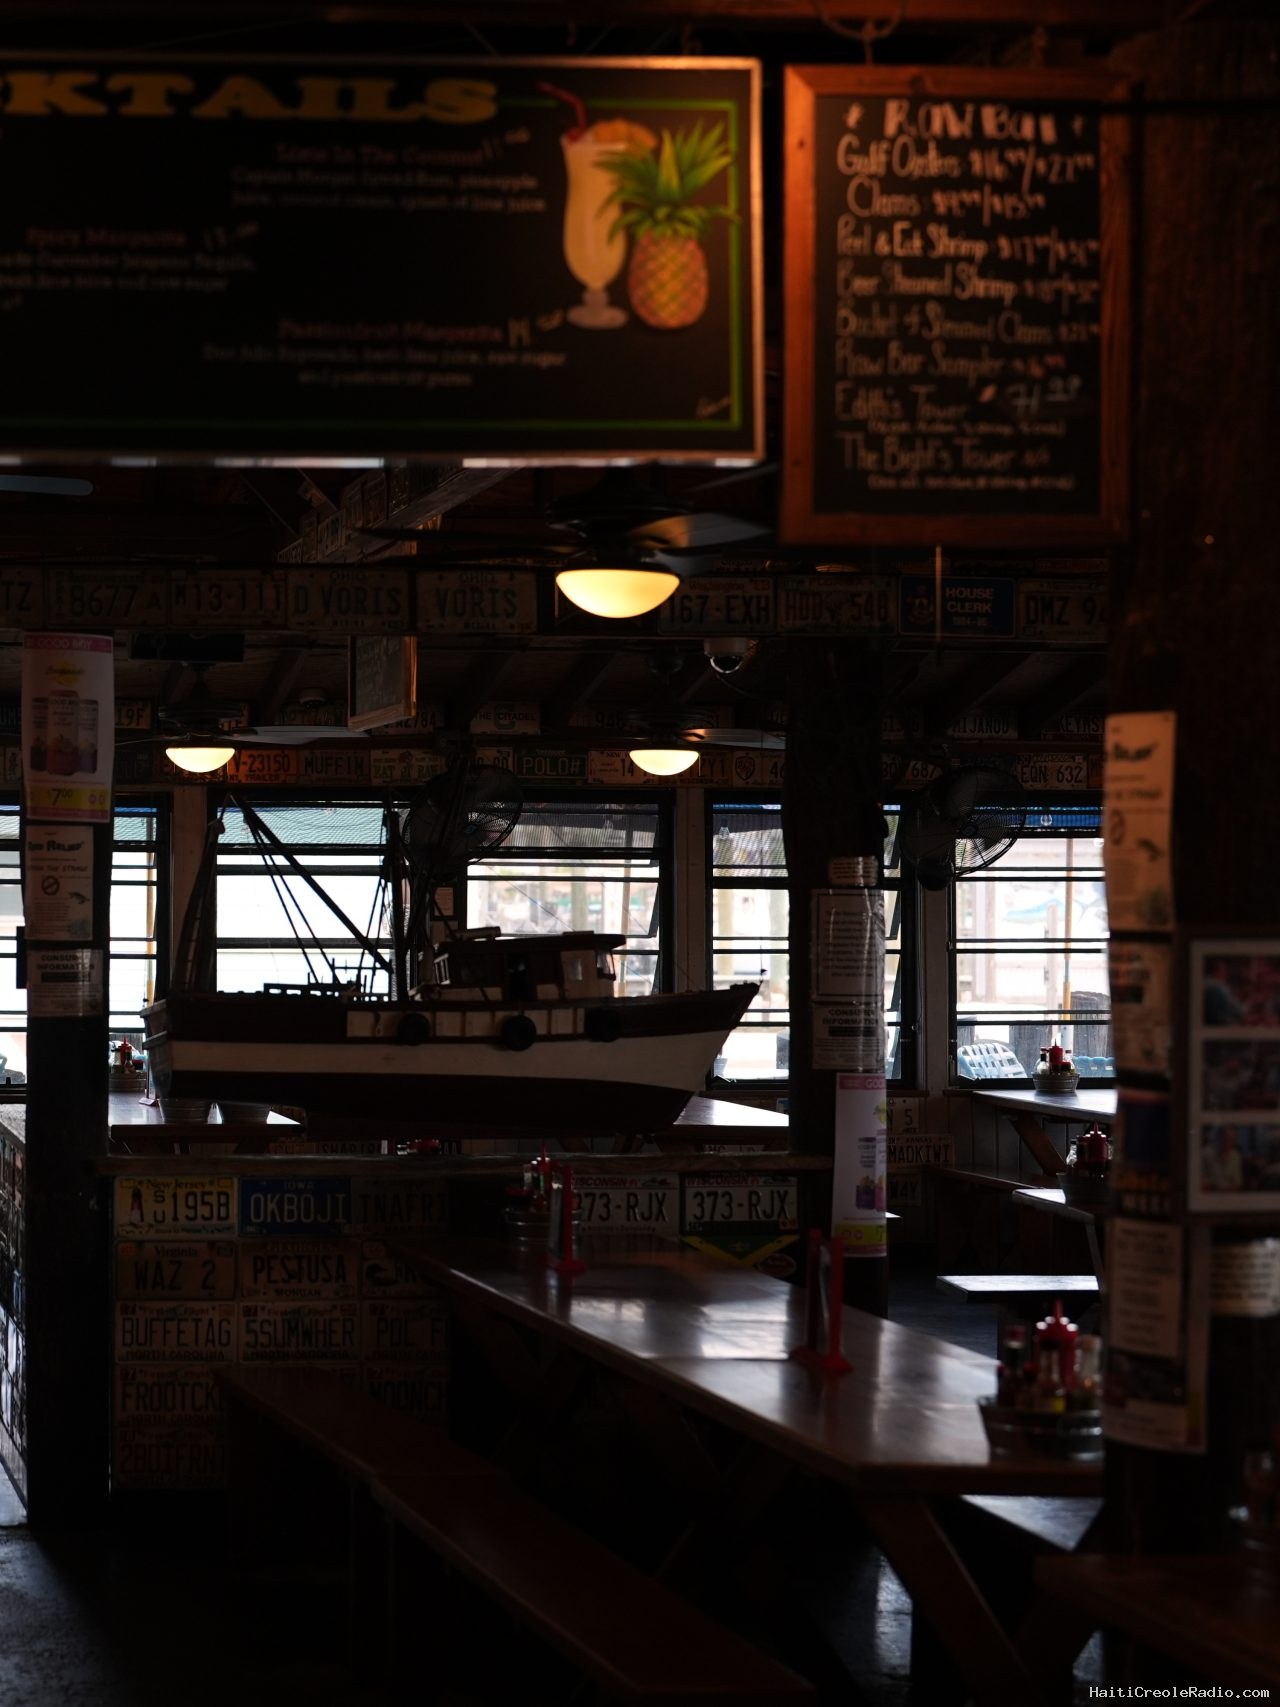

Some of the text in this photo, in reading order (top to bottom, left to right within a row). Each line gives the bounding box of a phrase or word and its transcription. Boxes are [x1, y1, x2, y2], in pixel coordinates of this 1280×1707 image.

[321, 586, 403, 616] VORIS
[436, 588, 518, 618] VORIS
[945, 586, 996, 600] HOUSE
[945, 601, 993, 614] CLERK
[303, 755, 365, 775] MUFFIN
[1056, 765, 1083, 784] 632
[249, 1192, 349, 1225] OKBOJI
[693, 1190, 789, 1222] 373-RJX
[121, 1316, 232, 1348] BUFFETAG
